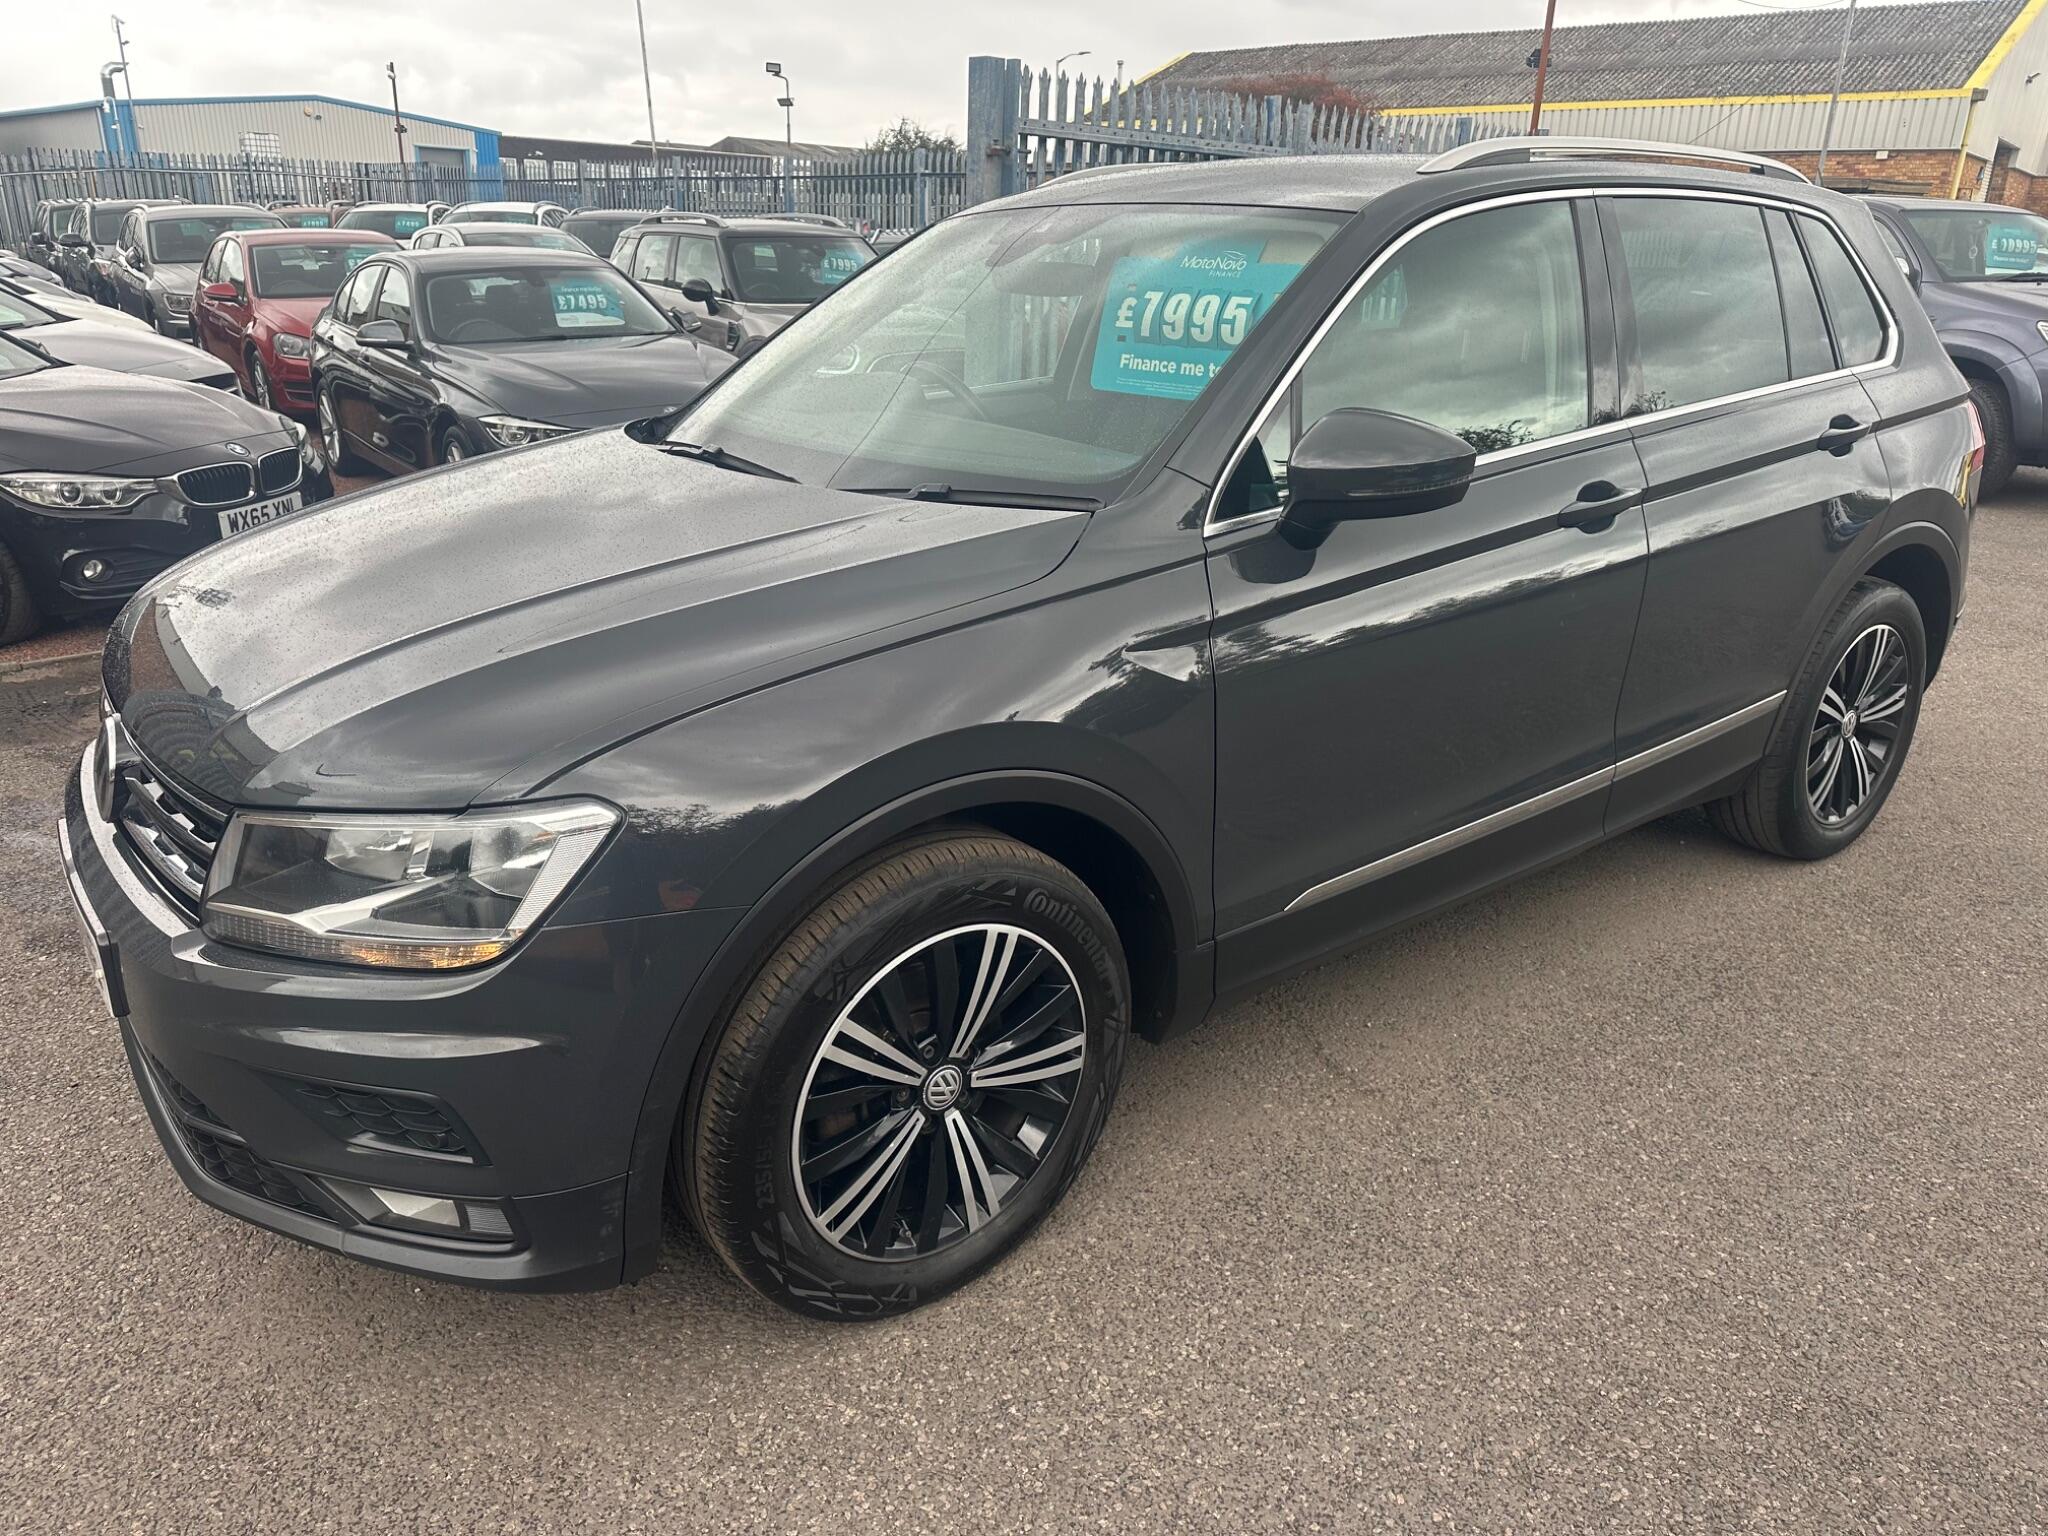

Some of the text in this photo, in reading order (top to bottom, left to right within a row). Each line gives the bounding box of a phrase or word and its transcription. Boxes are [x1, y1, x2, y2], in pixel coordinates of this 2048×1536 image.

[823, 257, 858, 272] £7995
[1179, 254, 1248, 271] MotoNovo
[1208, 269, 1242, 280] FINANCE
[556, 294, 608, 310] £7495
[1115, 290, 1254, 345] £7995
[1119, 353, 1177, 374] Finance
[1179, 361, 1205, 377] me
[227, 504, 271, 534] WX65
